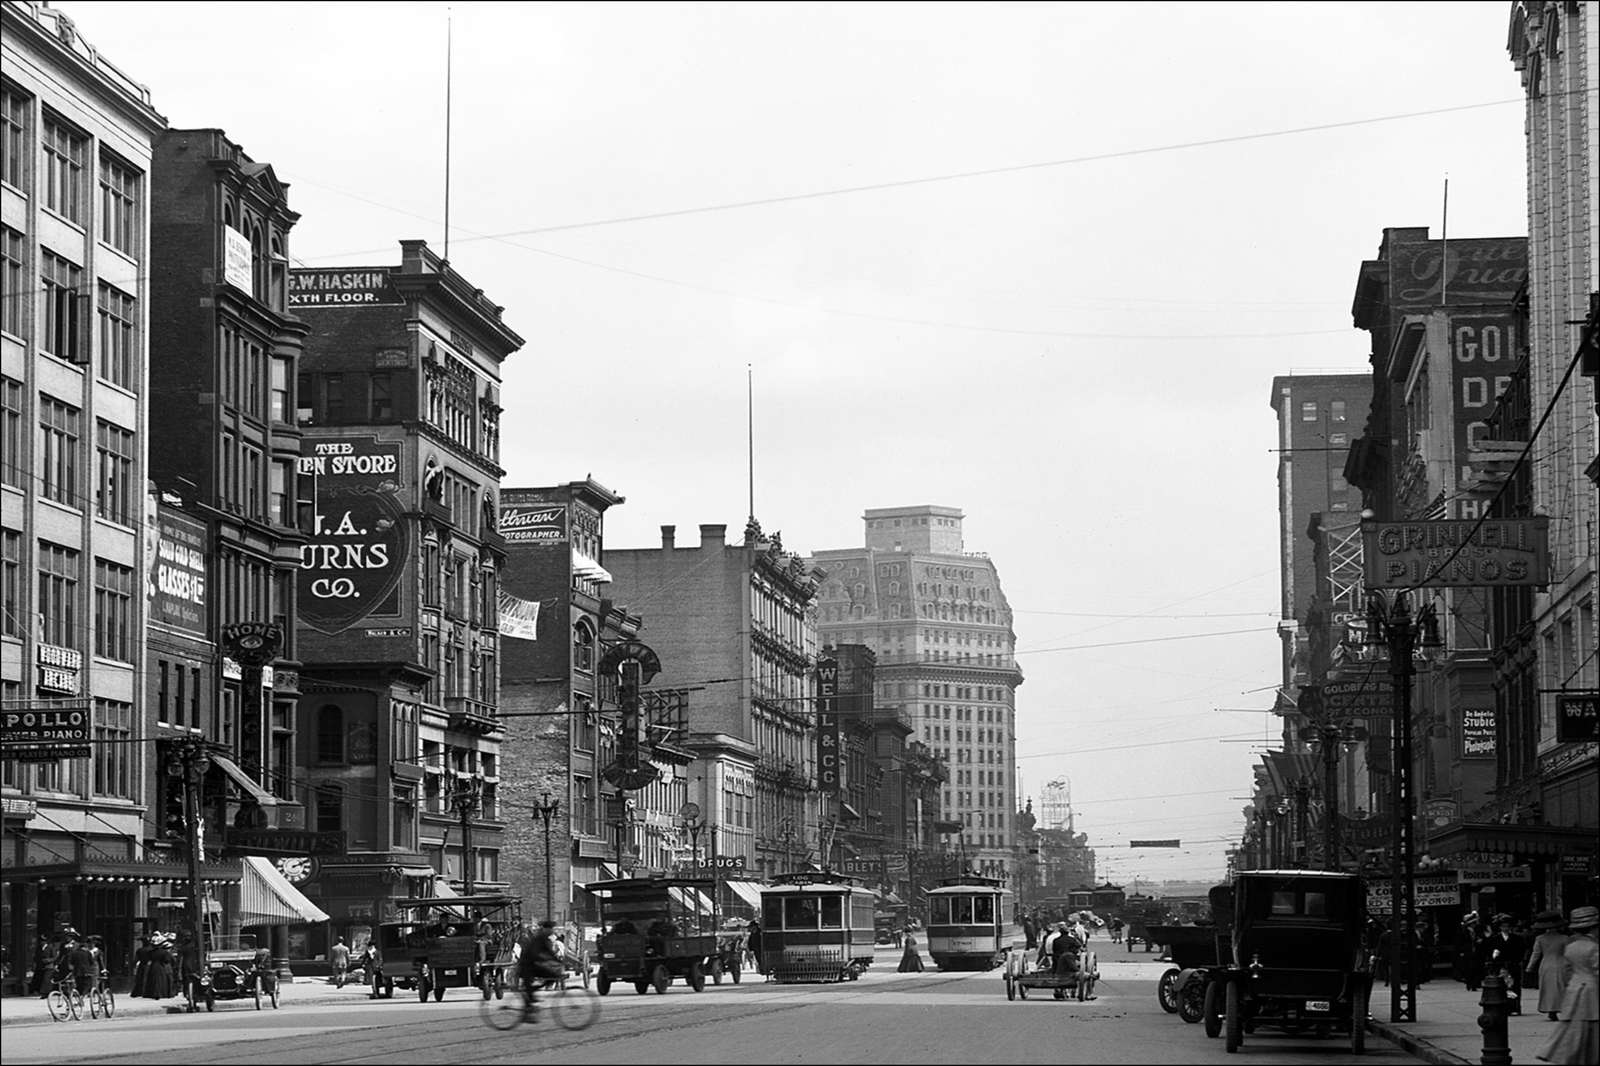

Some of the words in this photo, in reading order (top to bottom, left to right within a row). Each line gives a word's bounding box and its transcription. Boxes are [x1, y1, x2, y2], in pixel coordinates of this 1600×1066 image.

[289, 294, 320, 303] XTH
[325, 293, 380, 303] FLOOR.
[314, 442, 354, 456] THE
[296, 456, 326, 475] EN
[331, 454, 396, 475] STORE
[503, 530, 564, 540] OTOGRAPHER.
[300, 543, 389, 570] URNS
[1384, 558, 1529, 583] PIANOS
[310, 577, 360, 599] CO.
[227, 625, 278, 639] HOME
[818, 667, 837, 727] WEIL
[1, 711, 82, 729] POLLO
[43, 729, 83, 739] PIANO
[821, 734, 836, 748] &
